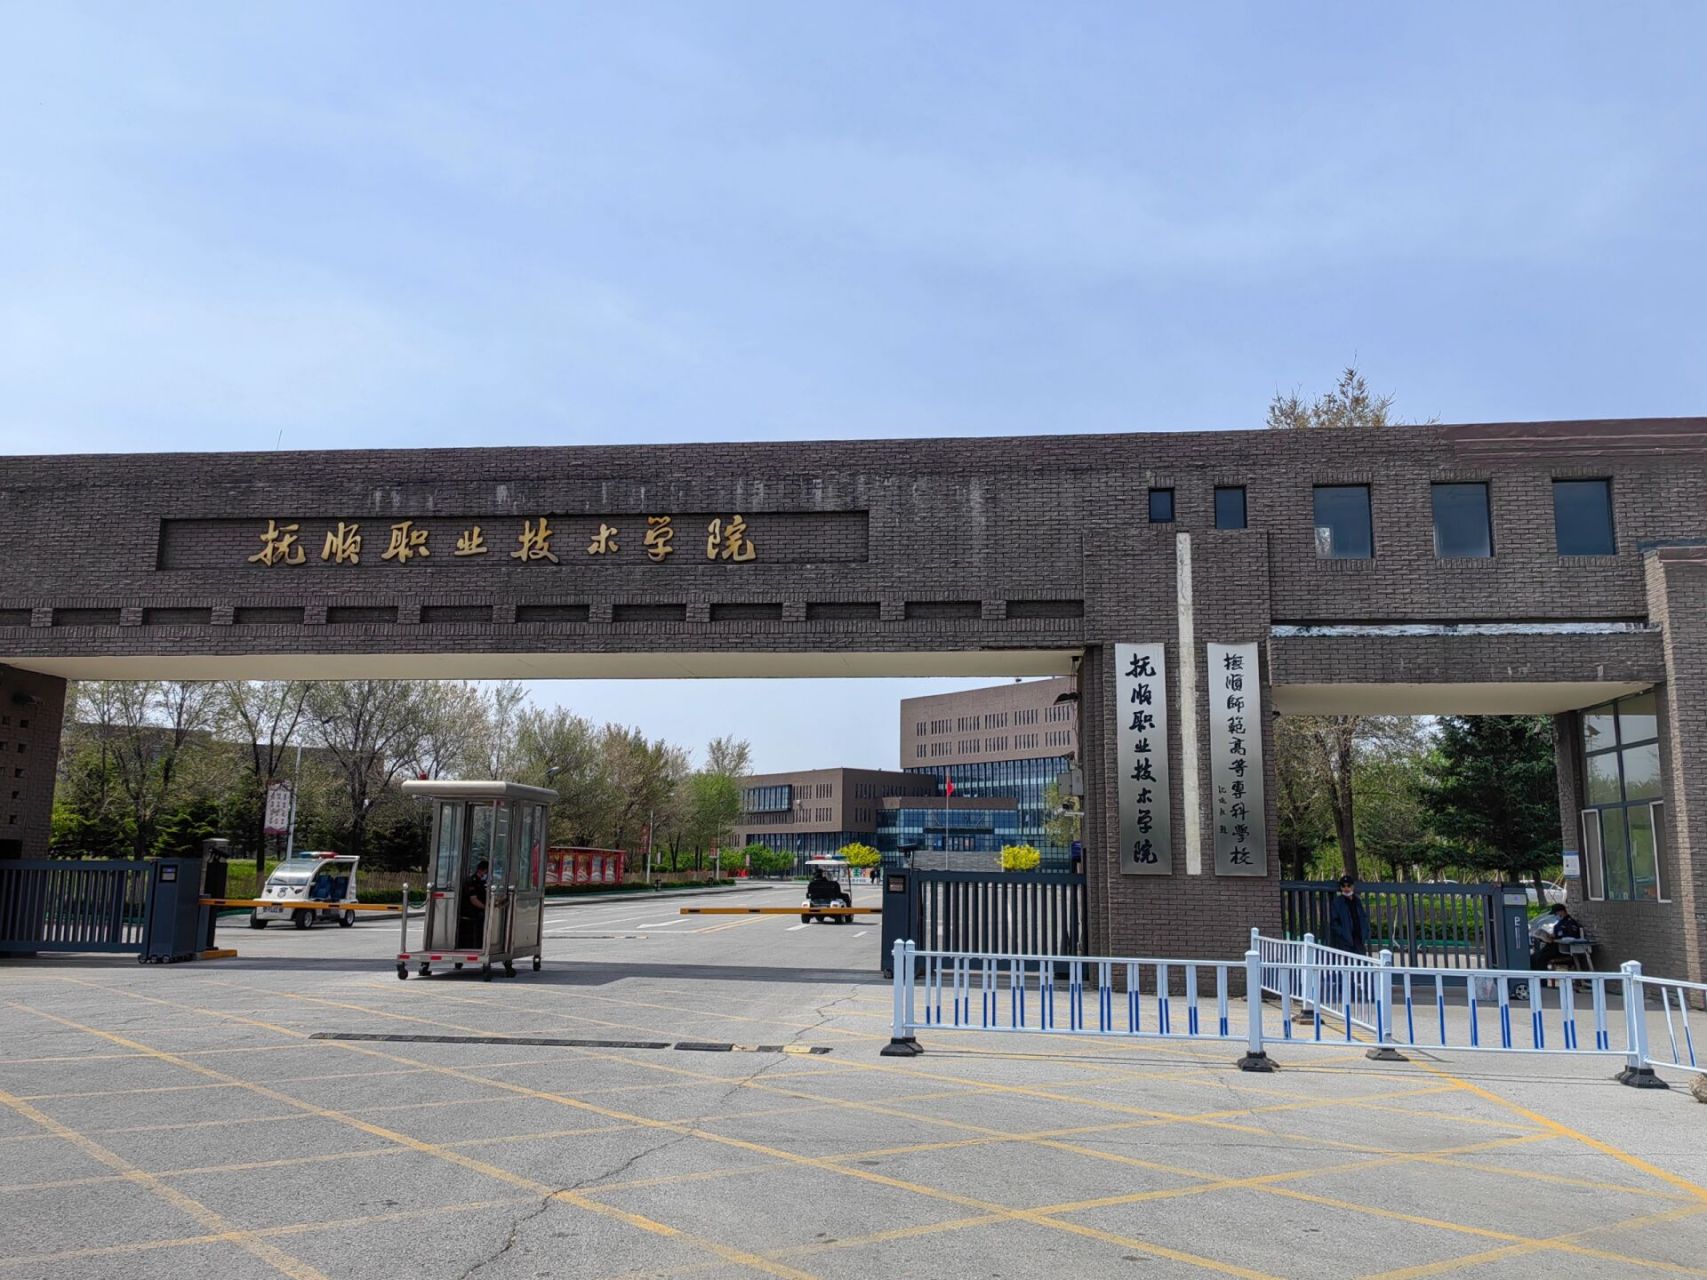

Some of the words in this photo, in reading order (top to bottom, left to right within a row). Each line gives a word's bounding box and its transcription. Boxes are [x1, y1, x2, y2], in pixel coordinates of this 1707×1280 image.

[248, 514, 757, 567] 抚顺职业技术学院
[1125, 653, 1158, 865] 抚顺职业技术学院
